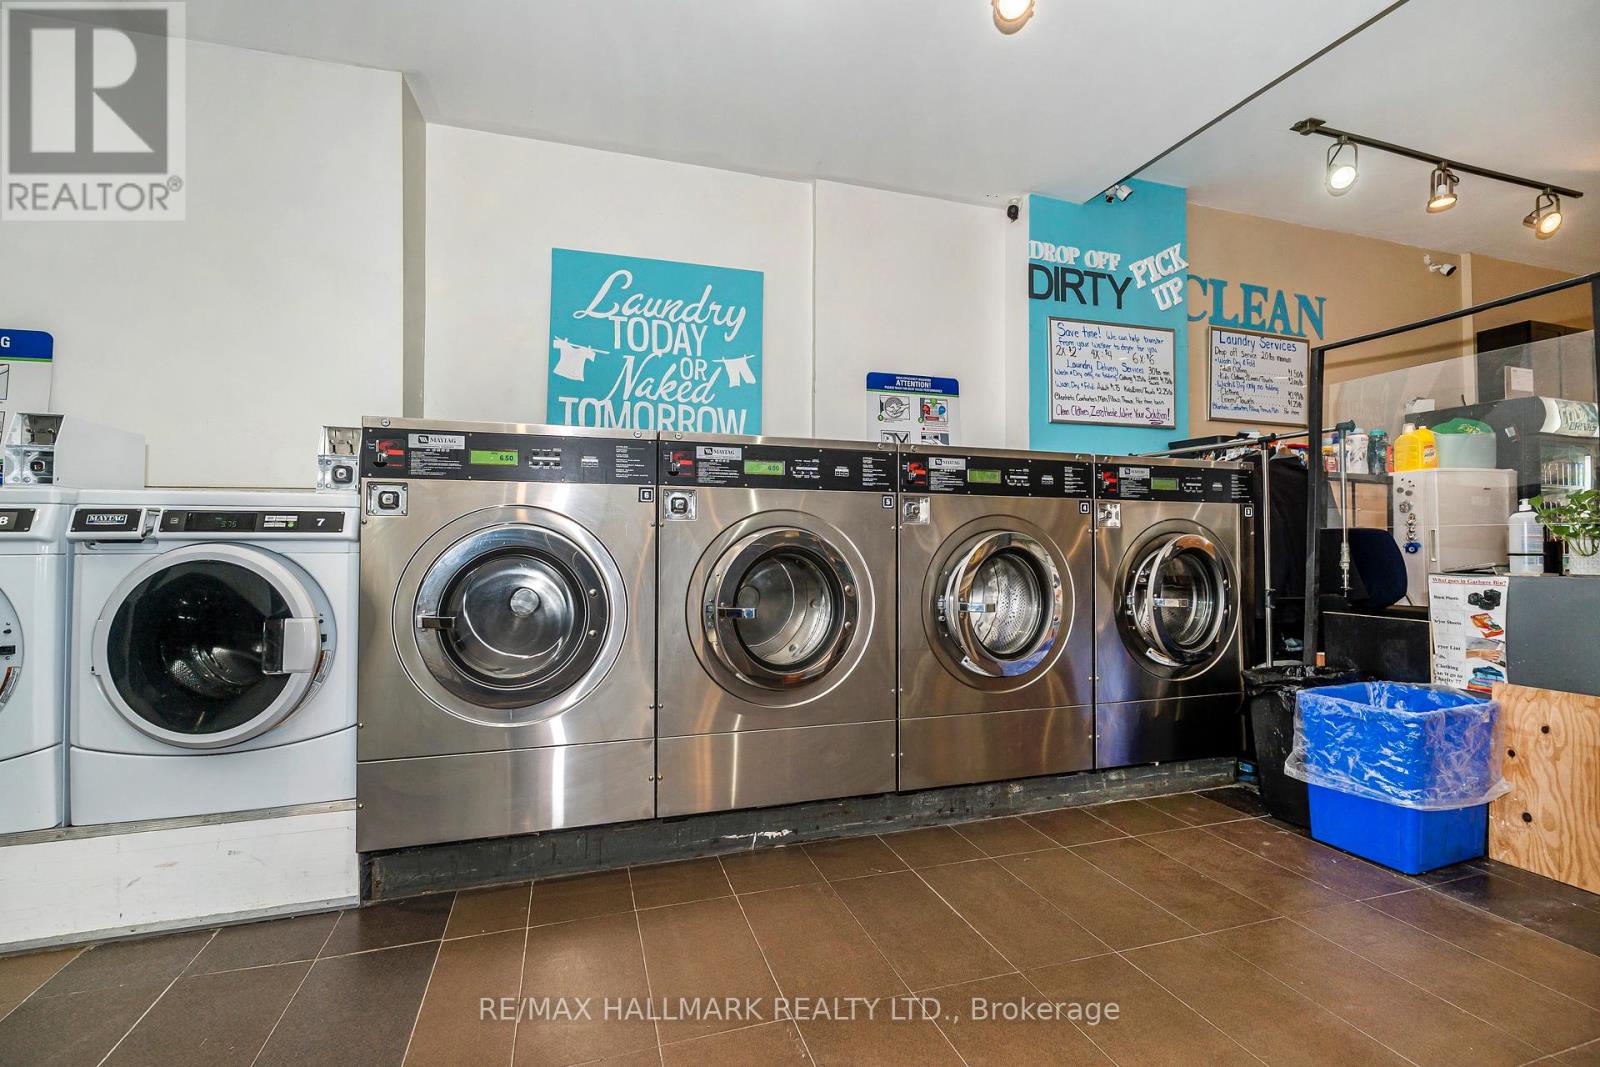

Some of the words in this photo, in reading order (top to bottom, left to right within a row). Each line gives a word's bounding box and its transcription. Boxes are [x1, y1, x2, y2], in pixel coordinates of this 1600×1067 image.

[1029, 240, 1080, 265] DROP
[1084, 250, 1121, 272] OFF
[1129, 243, 1189, 289] PICK
[1028, 263, 1132, 310] DIRTY
[1151, 277, 1184, 312] UP
[573, 270, 746, 342] Laundry
[1187, 274, 1327, 340] CLEAN
[608, 316, 708, 356] TODAY
[1056, 321, 1079, 338] Save
[1081, 325, 1101, 339] time!
[1219, 330, 1256, 352] Laundry
[1259, 336, 1297, 352] Services
[601, 352, 722, 404] Naked
[679, 357, 708, 381] OR
[1066, 359, 1093, 373] Laundry
[895, 379, 932, 389] ATTENTION!
[558, 396, 747, 434] TOMORROW
[316, 518, 327, 526] 7
